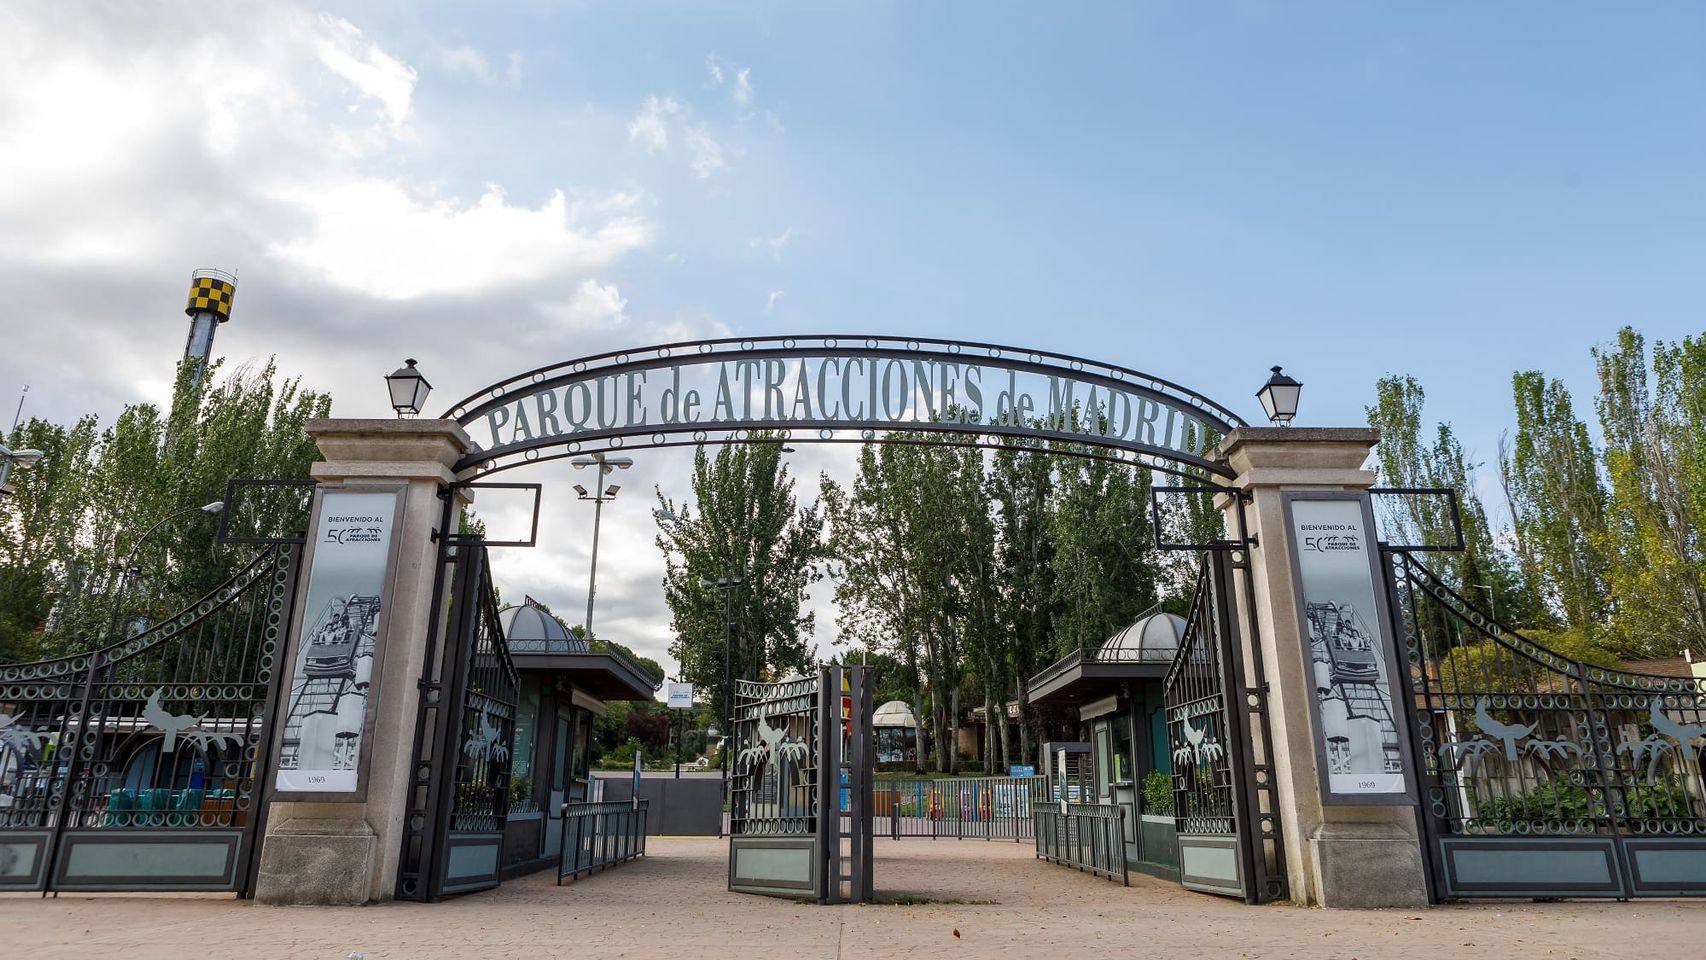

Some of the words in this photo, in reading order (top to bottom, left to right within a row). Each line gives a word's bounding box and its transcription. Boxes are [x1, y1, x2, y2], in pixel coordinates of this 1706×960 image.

[485, 368, 648, 449] PARQUE
[660, 366, 701, 425] de
[711, 356, 983, 427] ATRACCIONES
[997, 369, 1035, 429] de
[1046, 374, 1206, 458] MADRID
[308, 776, 326, 784] 1969
[1357, 781, 1376, 789] 1969
